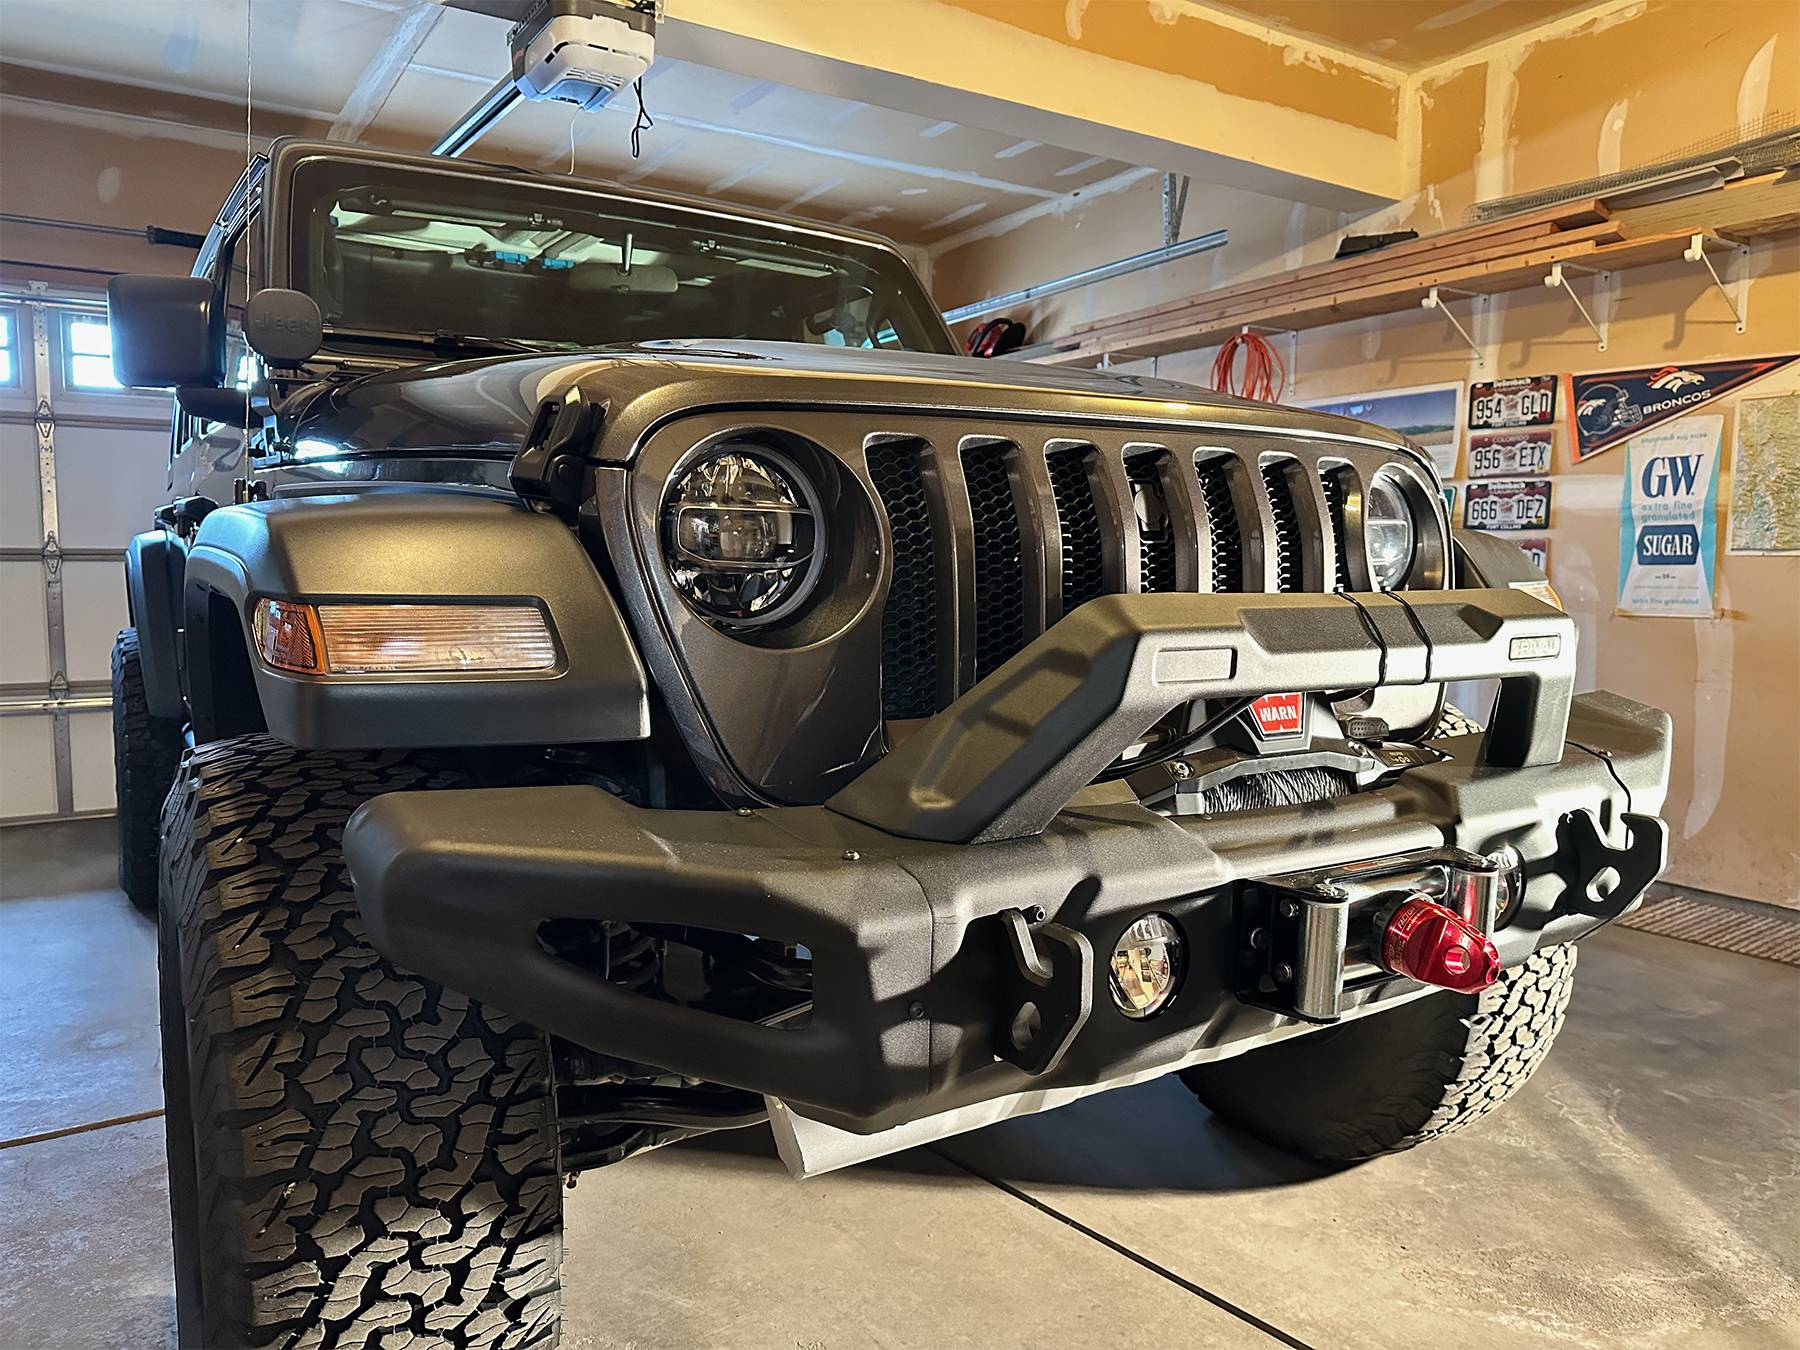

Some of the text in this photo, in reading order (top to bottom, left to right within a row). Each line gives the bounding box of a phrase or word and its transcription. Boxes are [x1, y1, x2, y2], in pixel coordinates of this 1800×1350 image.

[255, 311, 314, 338] Jeep
[1476, 399, 1502, 420] 954
[1642, 389, 1712, 415] BRONCOS
[1475, 446, 1546, 470] 956 EIX
[1472, 499, 1544, 520] 666 DEZ
[1641, 501, 1693, 512] extra fine
[1641, 511, 1696, 523] granulated
[1643, 534, 1694, 556] SUGAR
[1259, 705, 1297, 722] WARN
